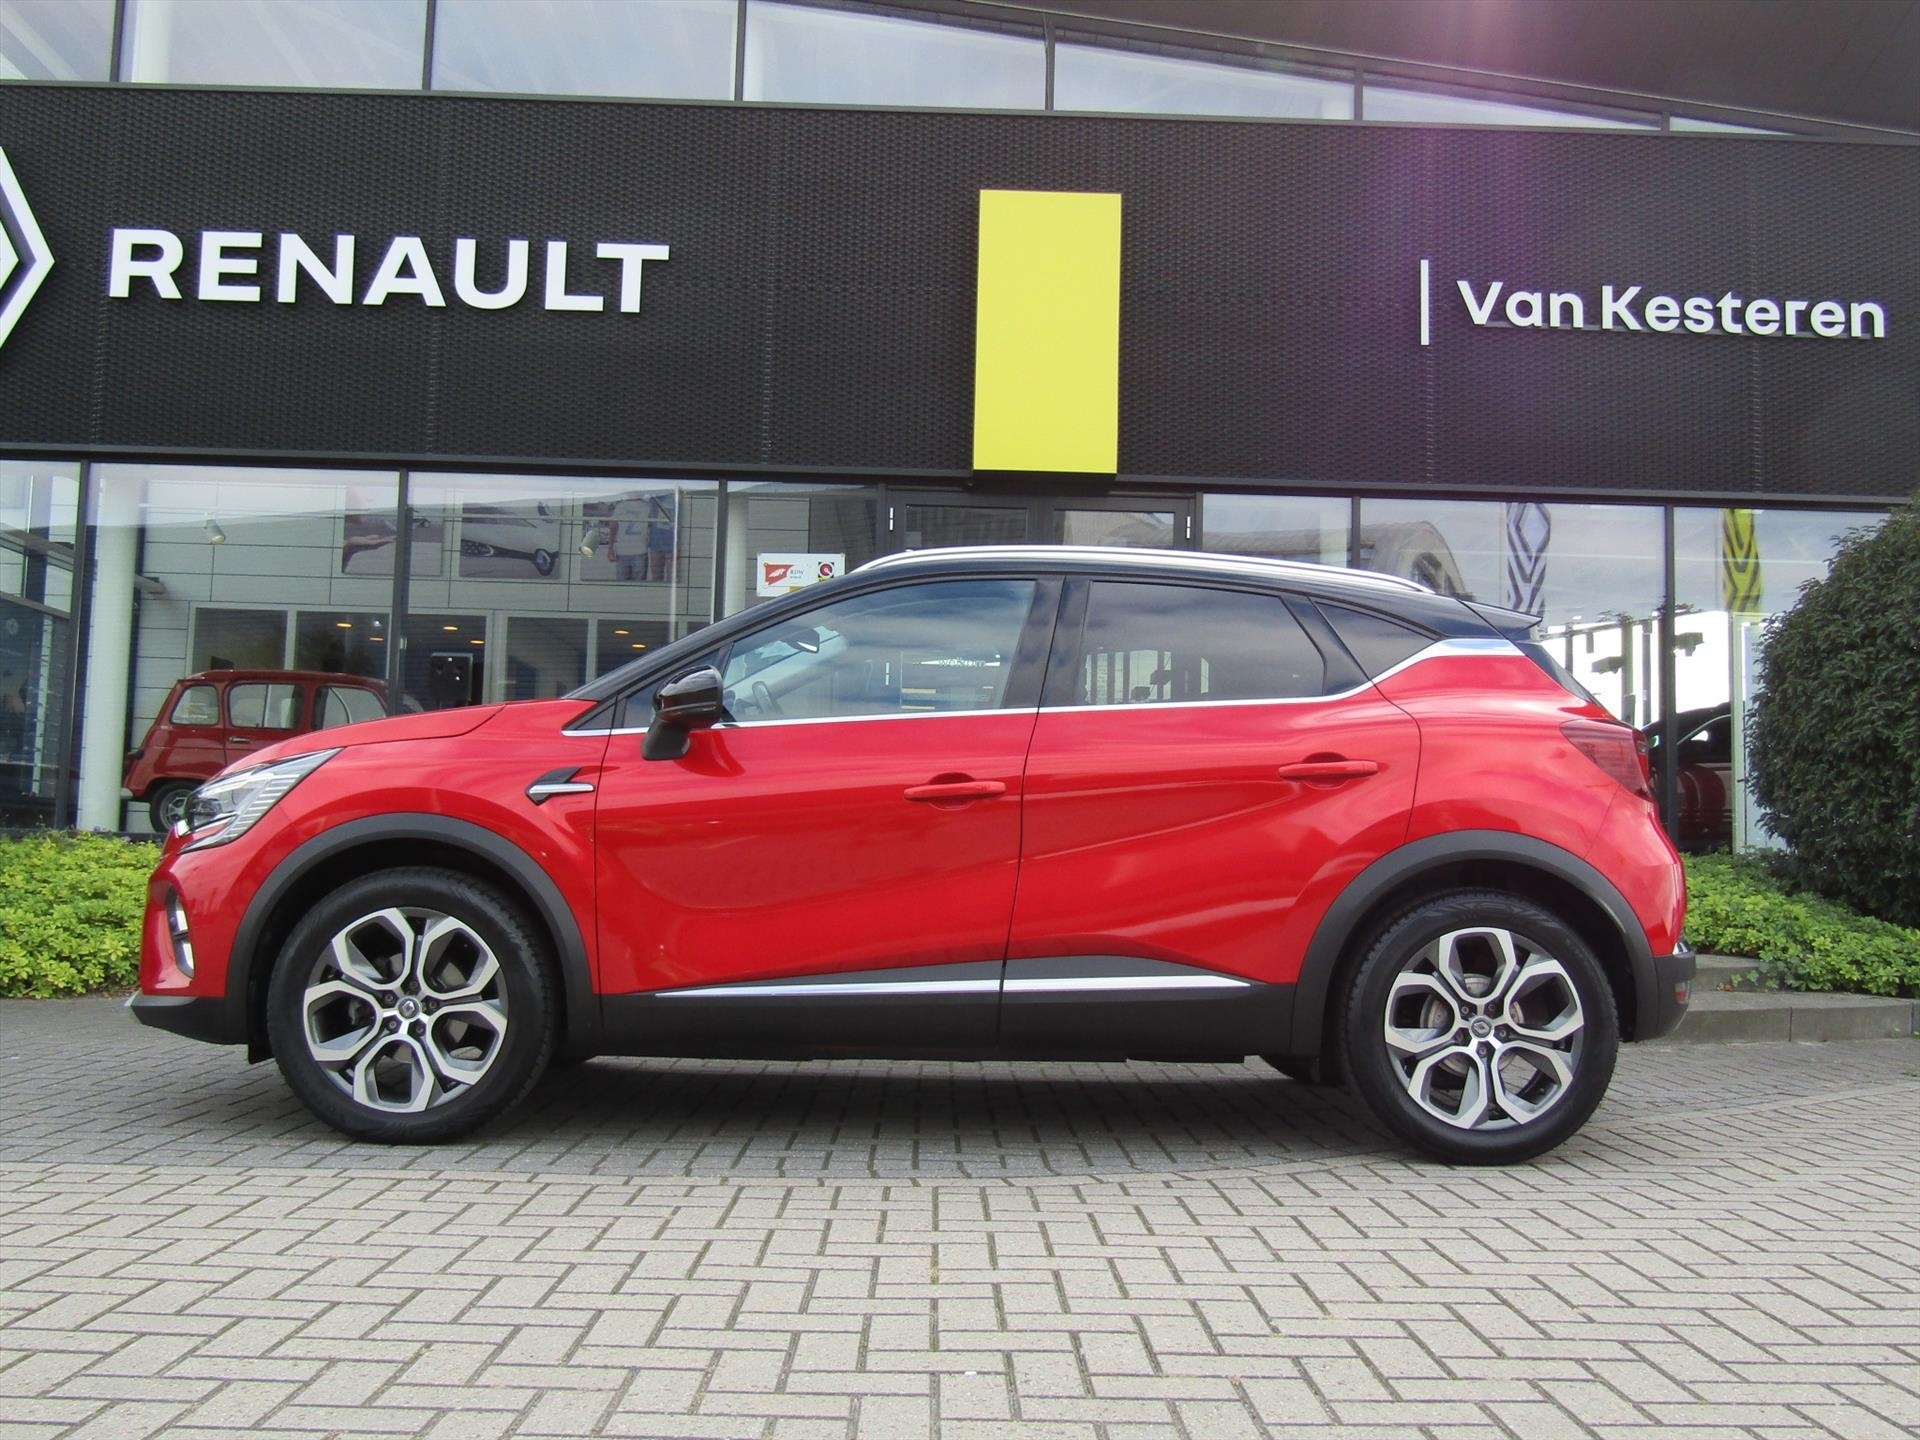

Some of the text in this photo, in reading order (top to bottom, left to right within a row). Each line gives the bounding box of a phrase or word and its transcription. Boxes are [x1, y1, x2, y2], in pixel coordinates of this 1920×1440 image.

[108, 228, 670, 313] RENAULT
[1456, 280, 1886, 338] Van Kesteren
